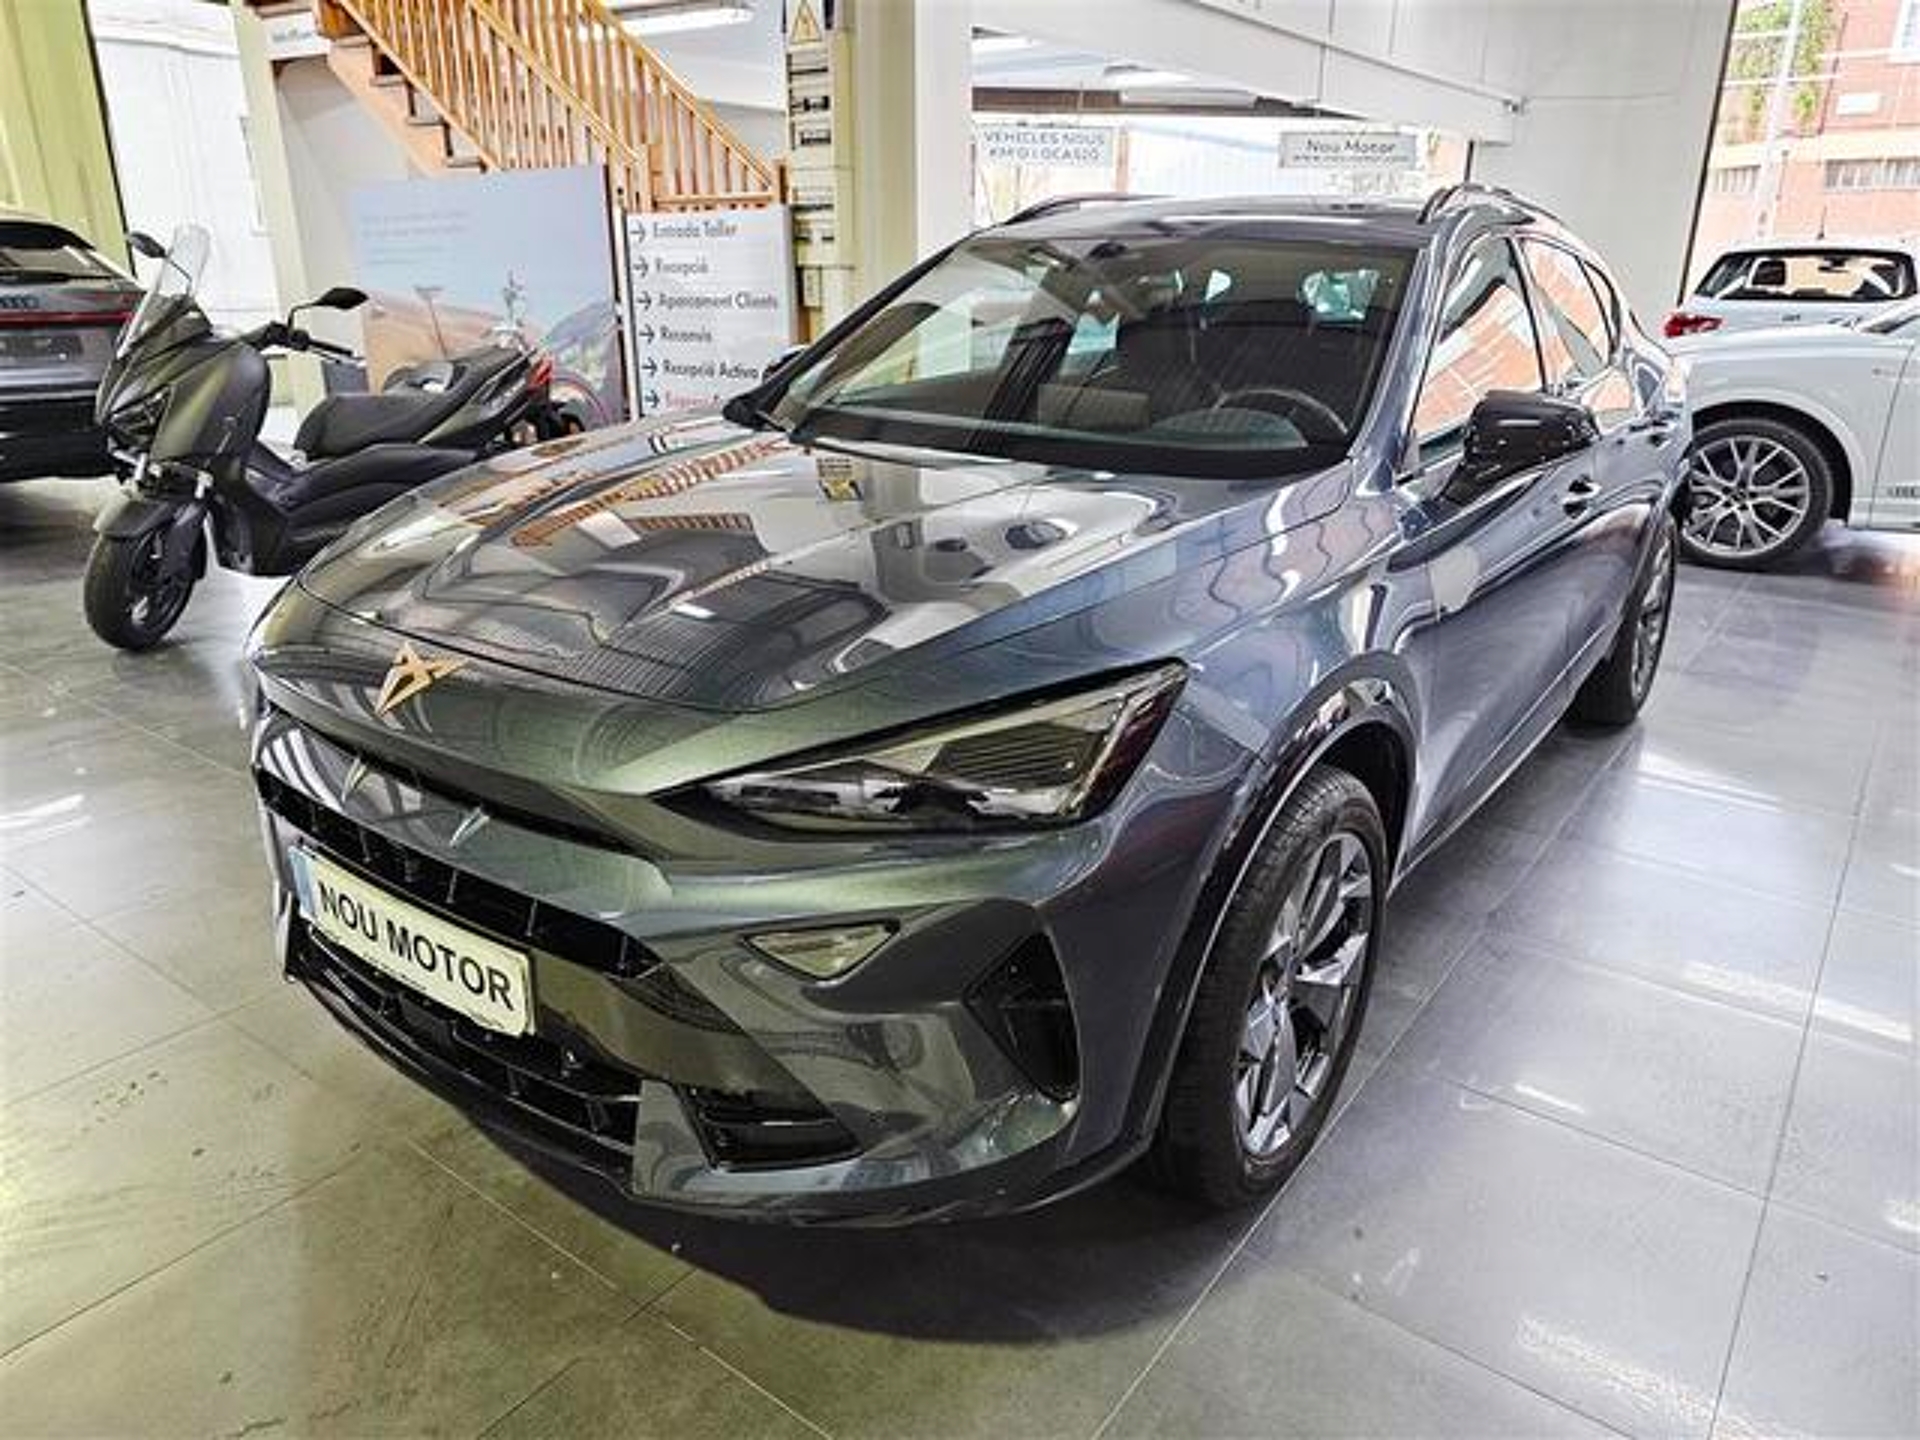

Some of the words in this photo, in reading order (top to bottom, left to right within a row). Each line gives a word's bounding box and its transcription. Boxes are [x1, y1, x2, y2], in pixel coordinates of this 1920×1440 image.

[983, 131, 1060, 144] VEHICLES
[1305, 138, 1342, 153] Nou
[1343, 140, 1396, 155] Motor
[652, 220, 700, 238] Entrada
[318, 880, 378, 939] NOU
[386, 918, 514, 1012] MOTOR
